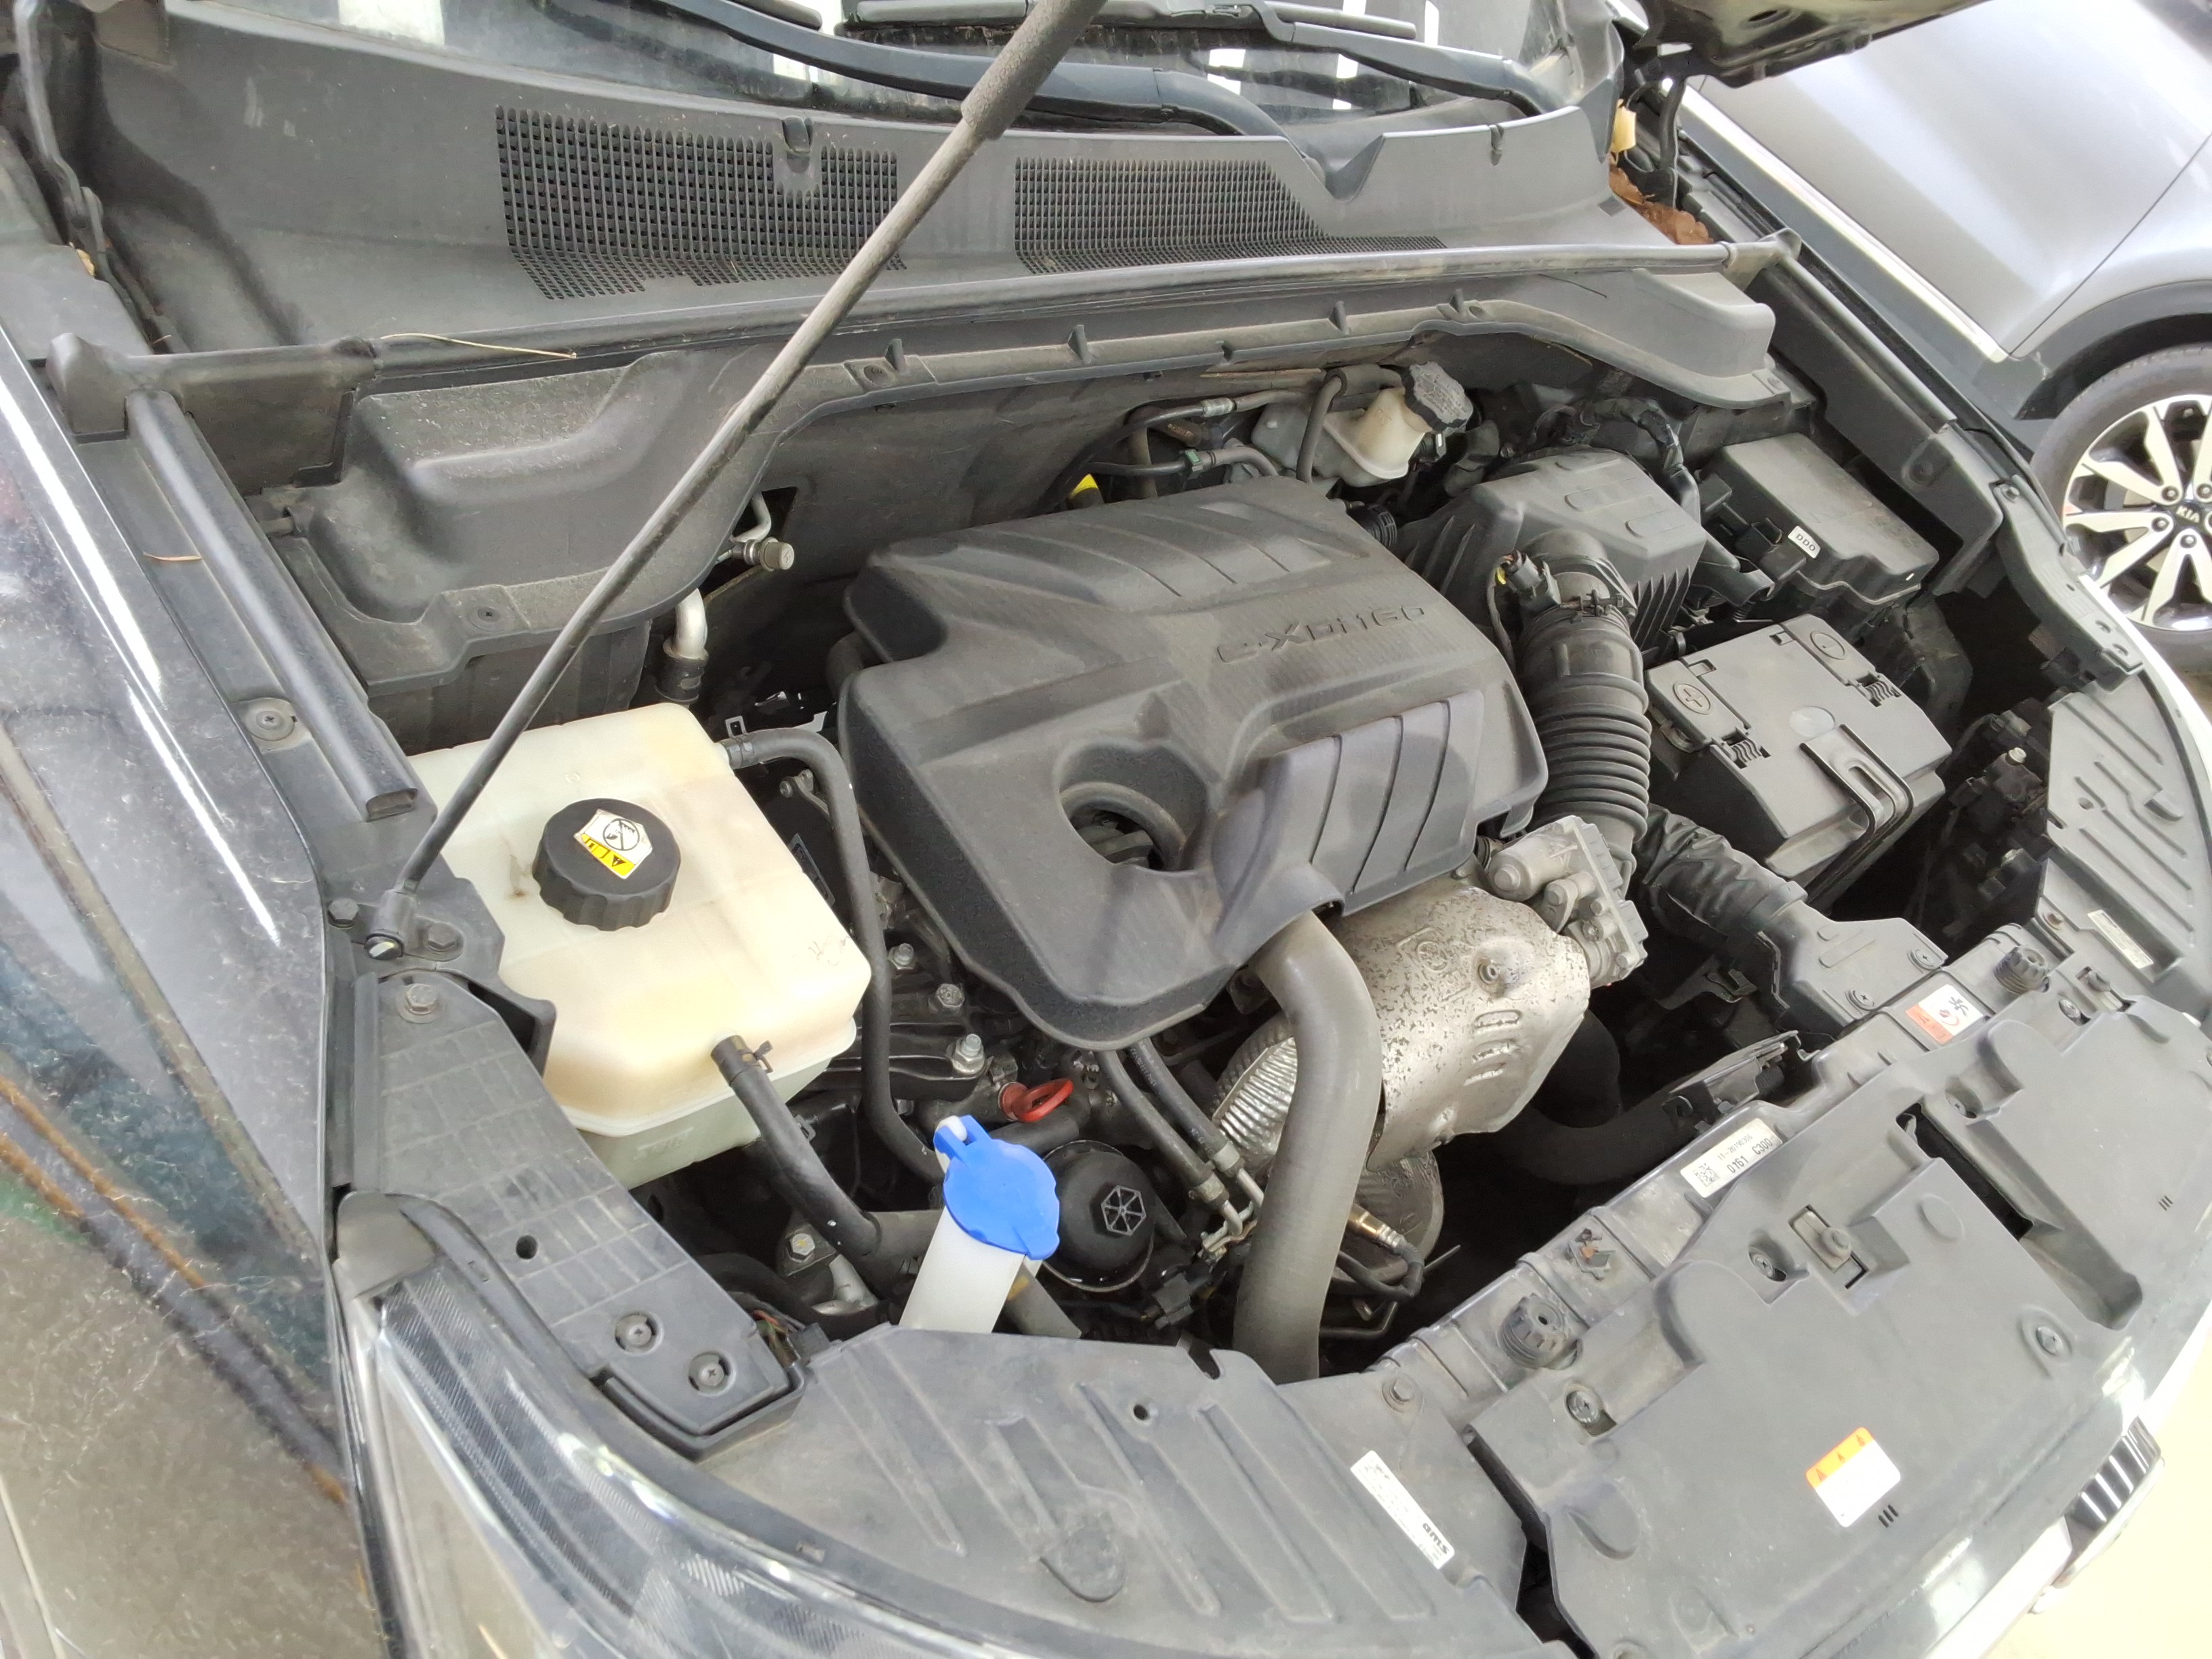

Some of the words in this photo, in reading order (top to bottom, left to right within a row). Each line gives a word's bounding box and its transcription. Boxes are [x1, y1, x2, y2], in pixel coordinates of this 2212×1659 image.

[2175, 505, 2200, 523] KIA
[1726, 1155, 1749, 1174] 0161
[1751, 1137, 1774, 1155] C300
[1422, 1522, 1450, 1555] ams
